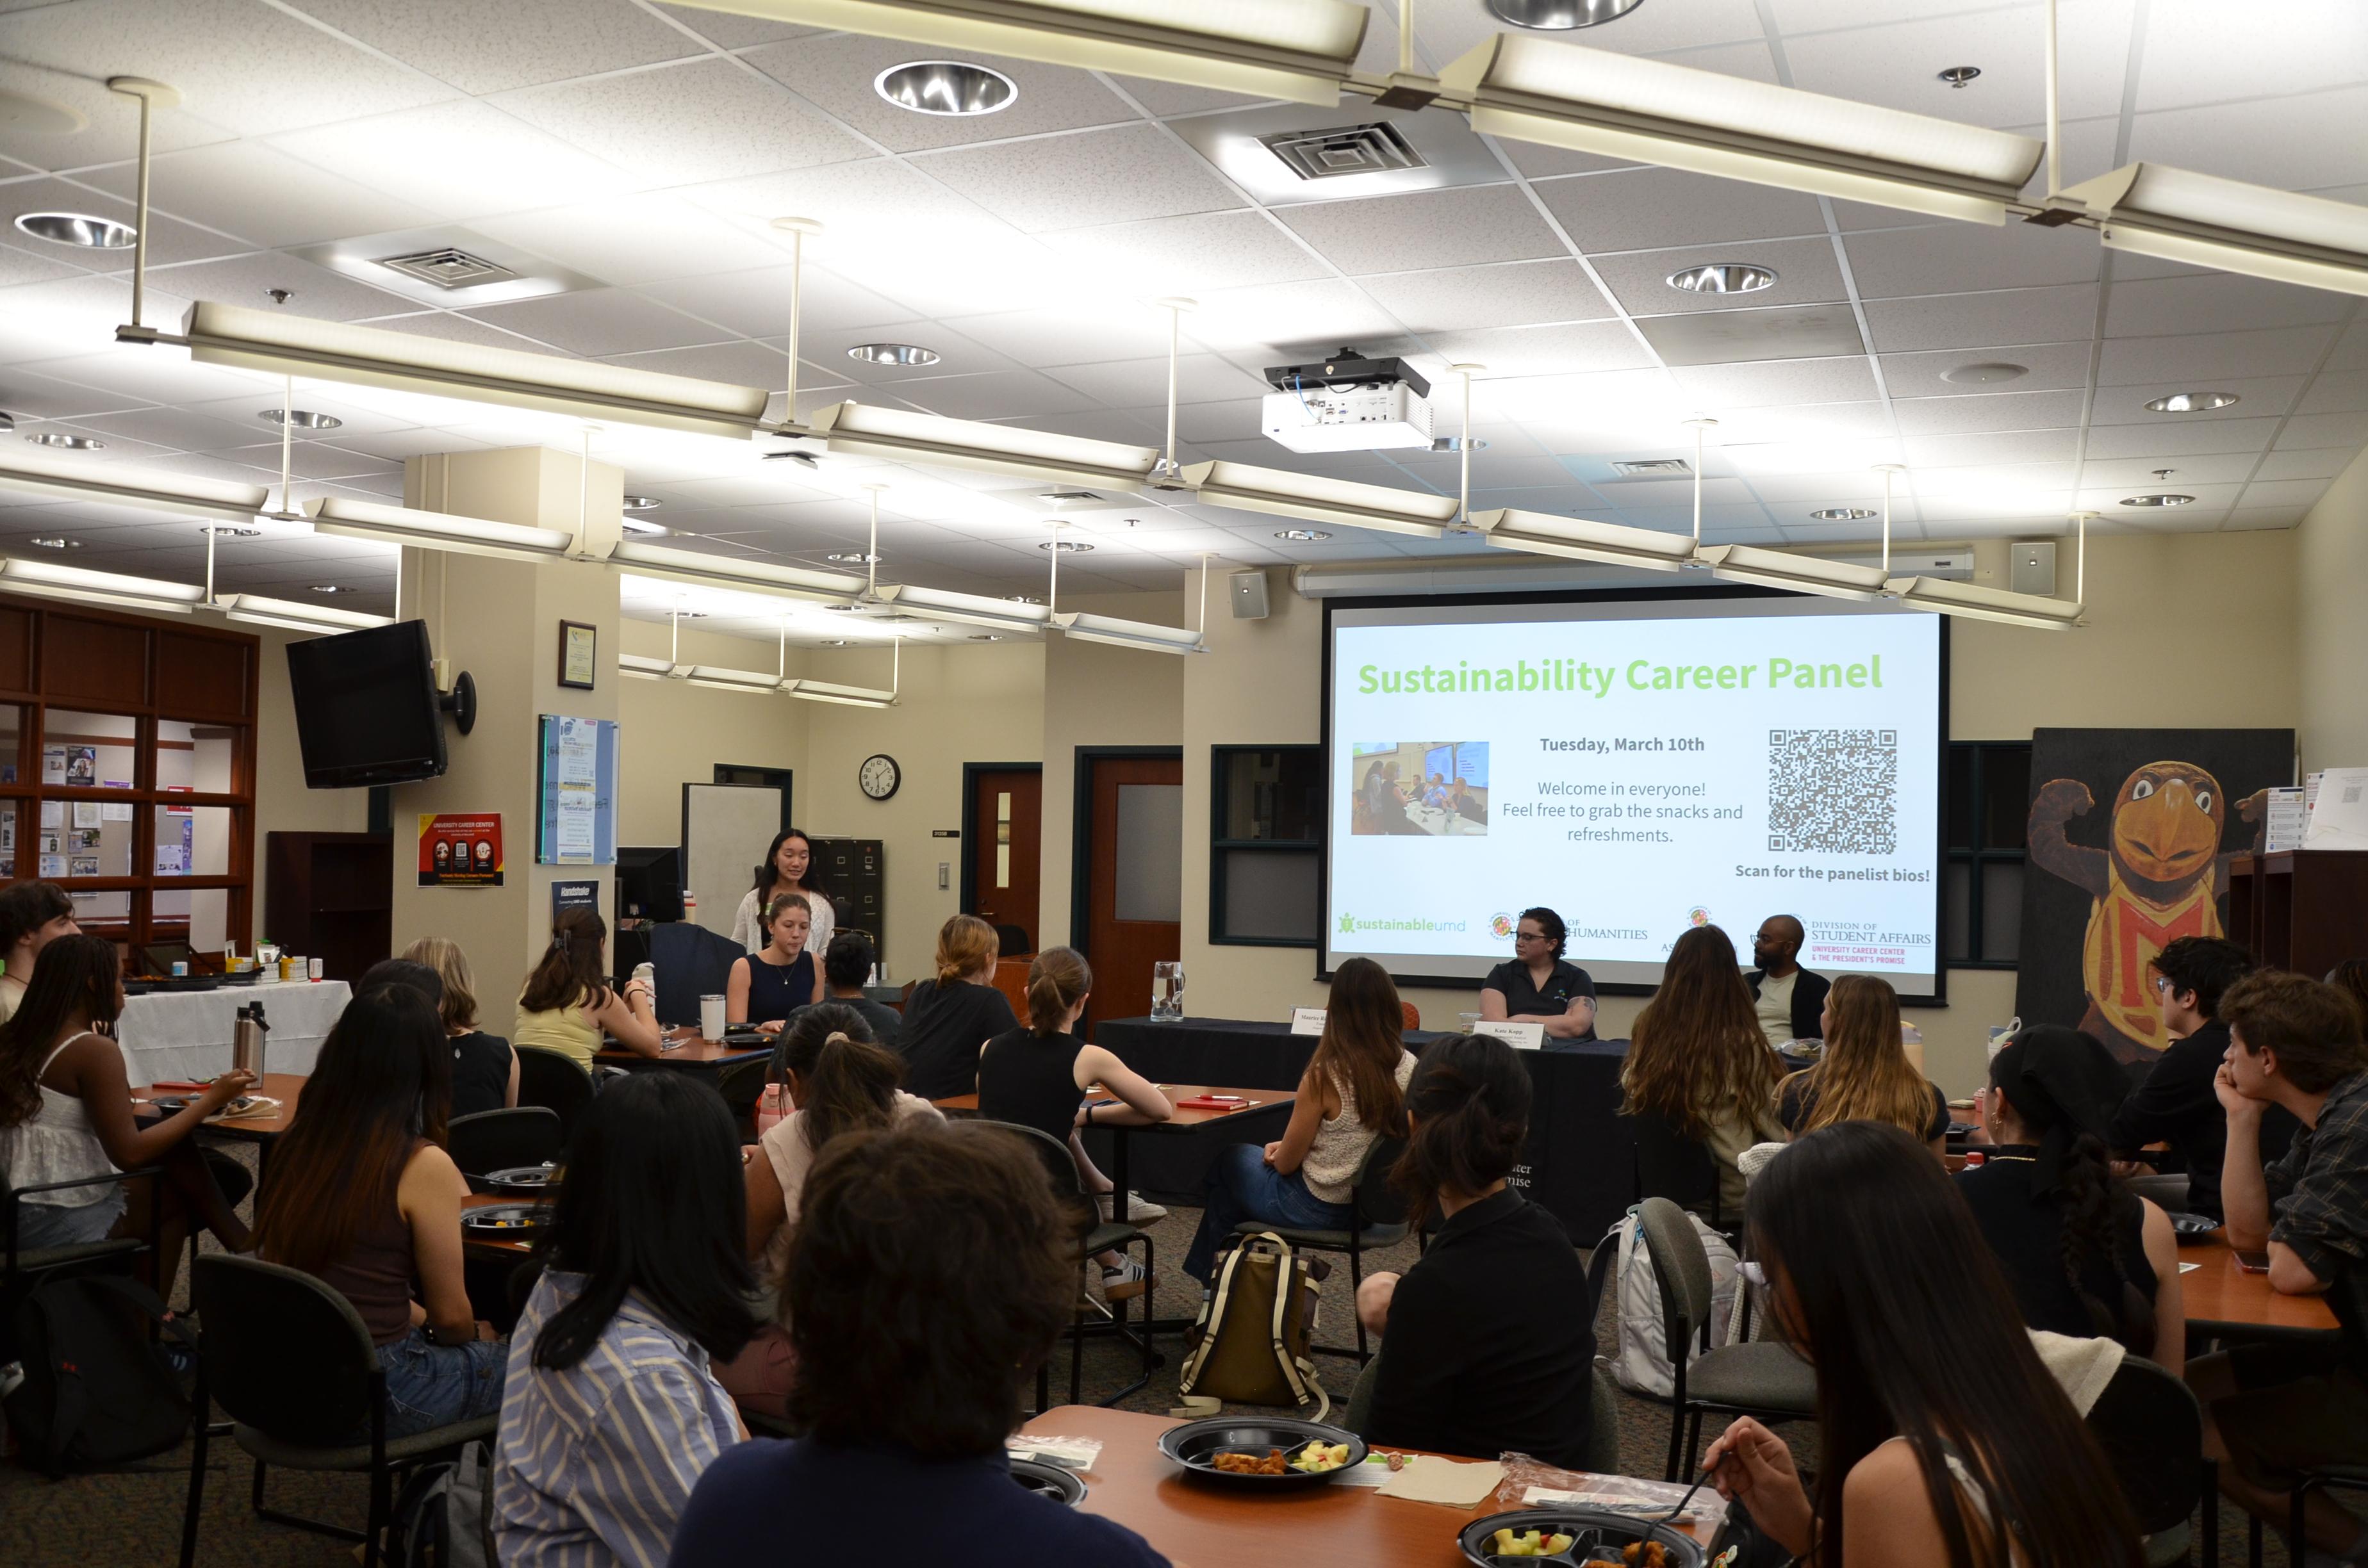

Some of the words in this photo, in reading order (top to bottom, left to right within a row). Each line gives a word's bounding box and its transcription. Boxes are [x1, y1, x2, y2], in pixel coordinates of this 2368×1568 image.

[1358, 660, 1615, 699] Sustainability
[1626, 660, 1757, 690] Career
[1769, 654, 1883, 689] Panel
[1540, 737, 1610, 755] Tuesday,
[1615, 737, 1663, 751] March
[1668, 737, 1705, 751] 10th
[1538, 781, 1607, 796] Welcome
[1611, 781, 1624, 796] in
[1629, 782, 1706, 799] everyone!
[1503, 803, 1533, 817] Feel
[1537, 803, 1566, 817] free
[1570, 805, 1585, 817] to
[1590, 803, 1623, 821] grab
[1627, 804, 1652, 818] the
[1656, 804, 1709, 819] snacks
[1714, 804, 1743, 819] and
[1568, 827, 1673, 842] refreshments.
[1735, 865, 1770, 878] Scan
[1773, 865, 1795, 878] for
[1798, 866, 1824, 879] the
[1828, 868, 1889, 883] panelist
[1893, 869, 1930, 883] bios!
[1356, 917, 1466, 933] sustainableumd
[1812, 921, 1859, 930] DIVISION
[1568, 928, 1649, 940] HUMANITIES
[1811, 930, 1876, 942] STUDENT
[1879, 933, 1932, 944] AFFAIRS
[1832, 955, 1874, 963] PRESIDENT'S
[1876, 956, 1905, 965] PROMISE
